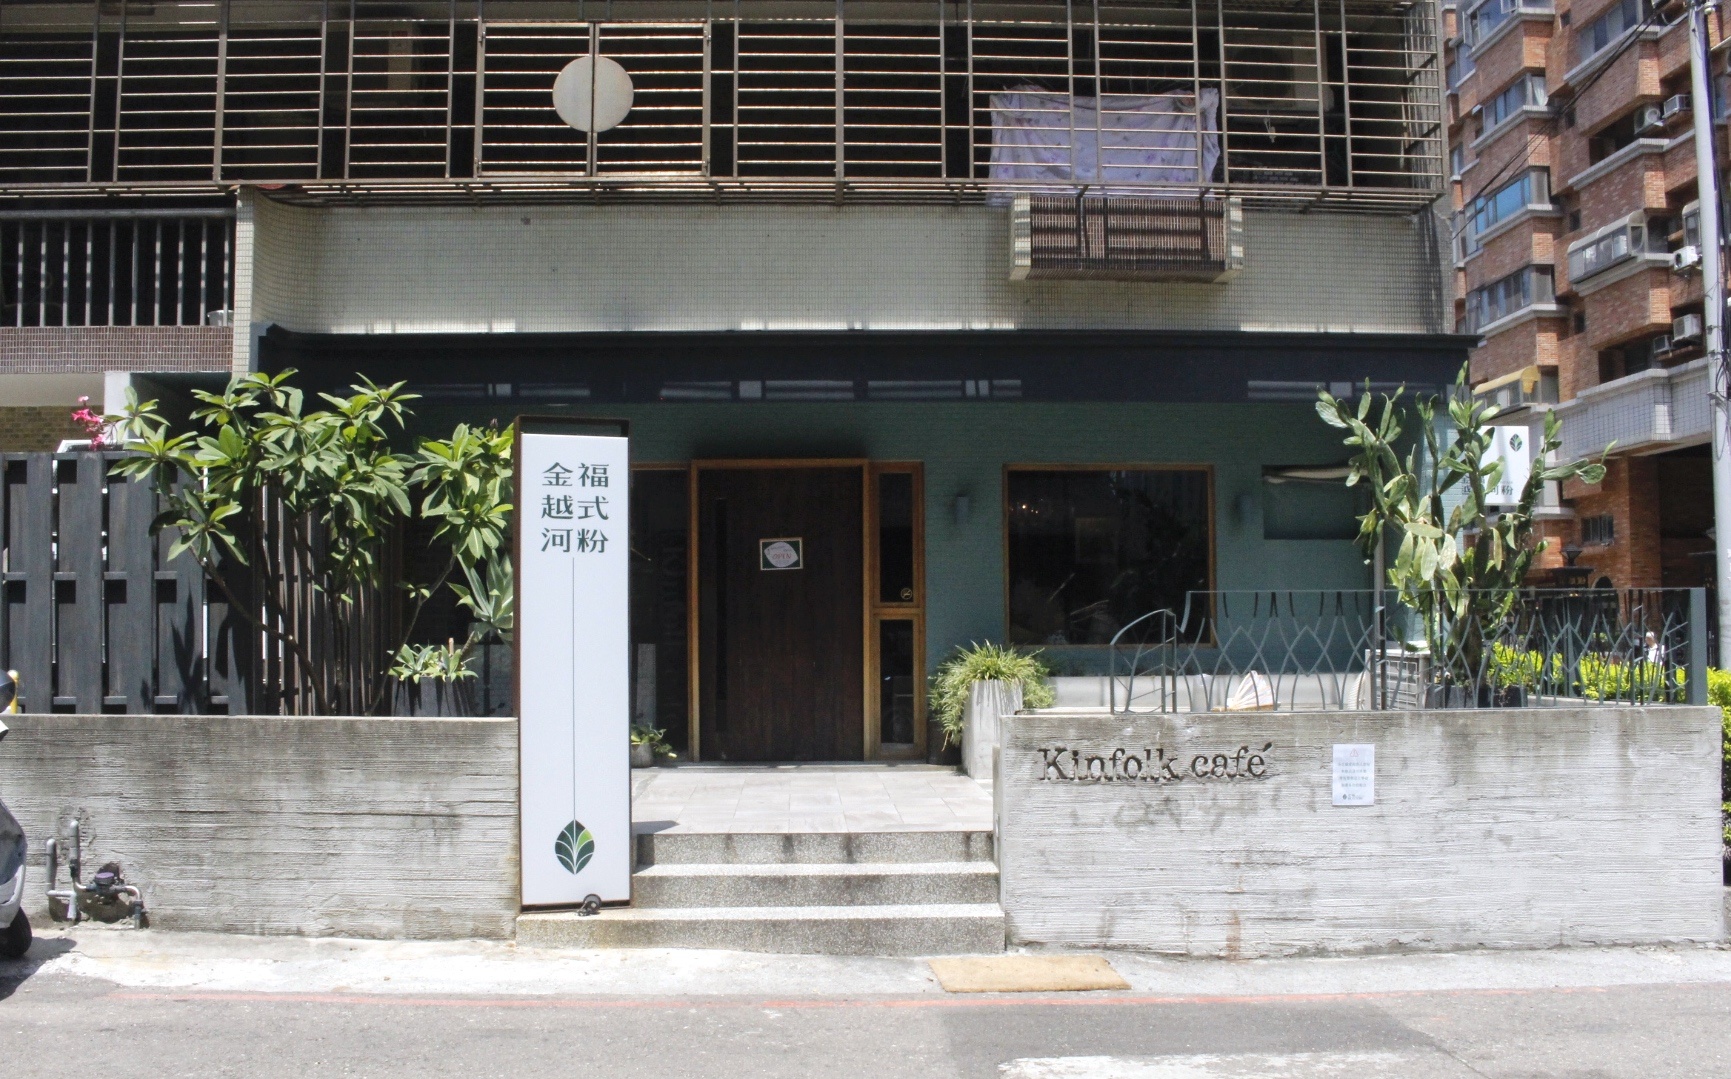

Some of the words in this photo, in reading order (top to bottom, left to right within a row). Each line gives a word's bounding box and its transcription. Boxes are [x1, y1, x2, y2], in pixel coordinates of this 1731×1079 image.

[541, 461, 609, 488] 金福
[541, 494, 609, 521] 越式
[541, 527, 609, 554] 河粉
[1037, 748, 1180, 781] Kinfolk
[1191, 742, 1273, 779] café
